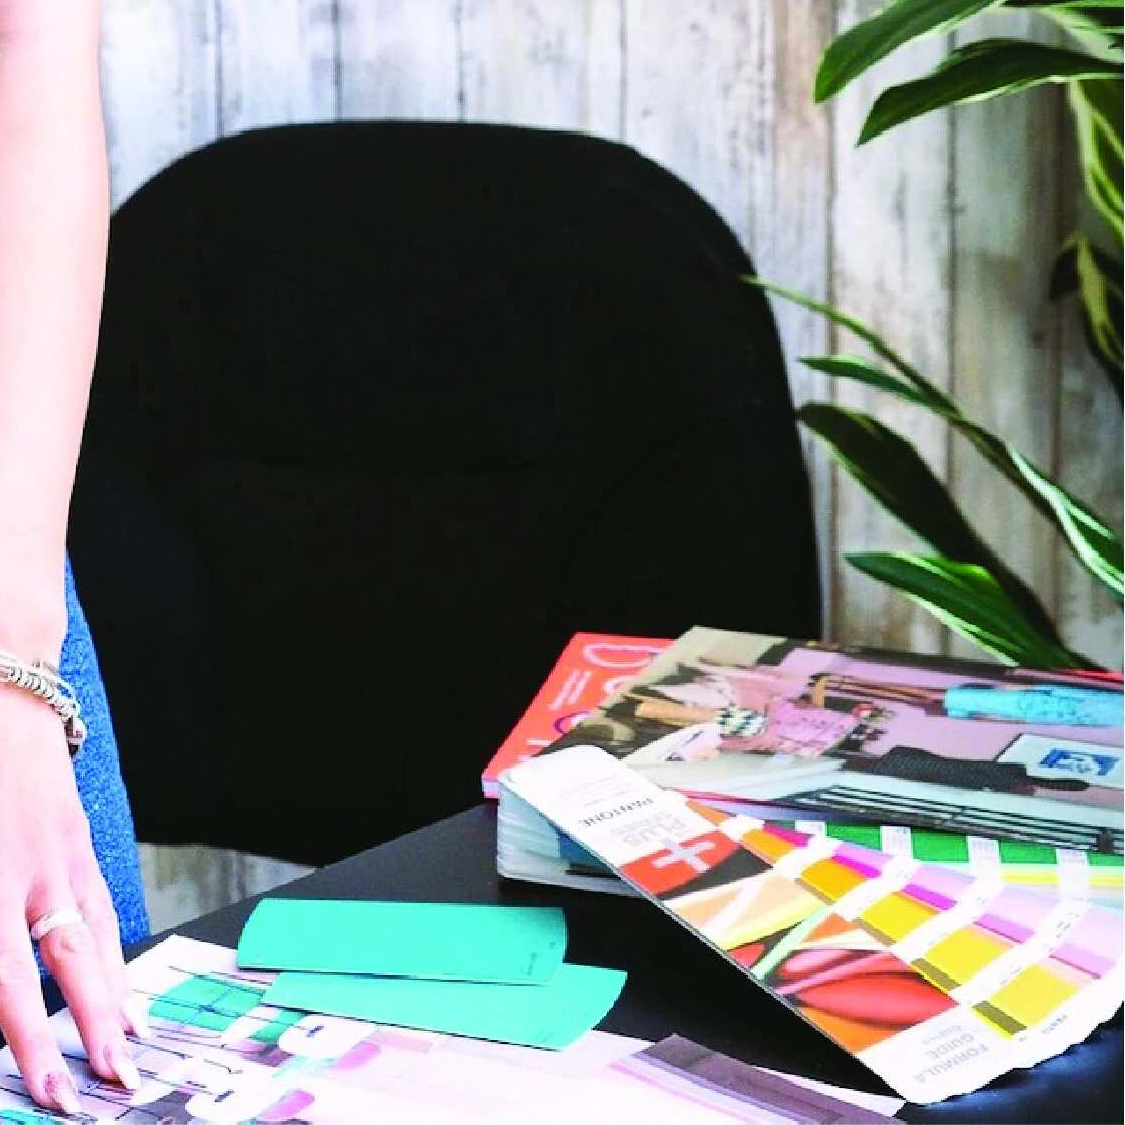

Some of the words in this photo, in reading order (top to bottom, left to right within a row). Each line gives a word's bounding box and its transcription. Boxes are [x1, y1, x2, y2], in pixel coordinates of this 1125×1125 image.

[578, 797, 654, 826] PANTONE
[622, 817, 685, 845] PLUS
[926, 1033, 974, 1059] GUIDE
[914, 1043, 989, 1083] FORMULA
